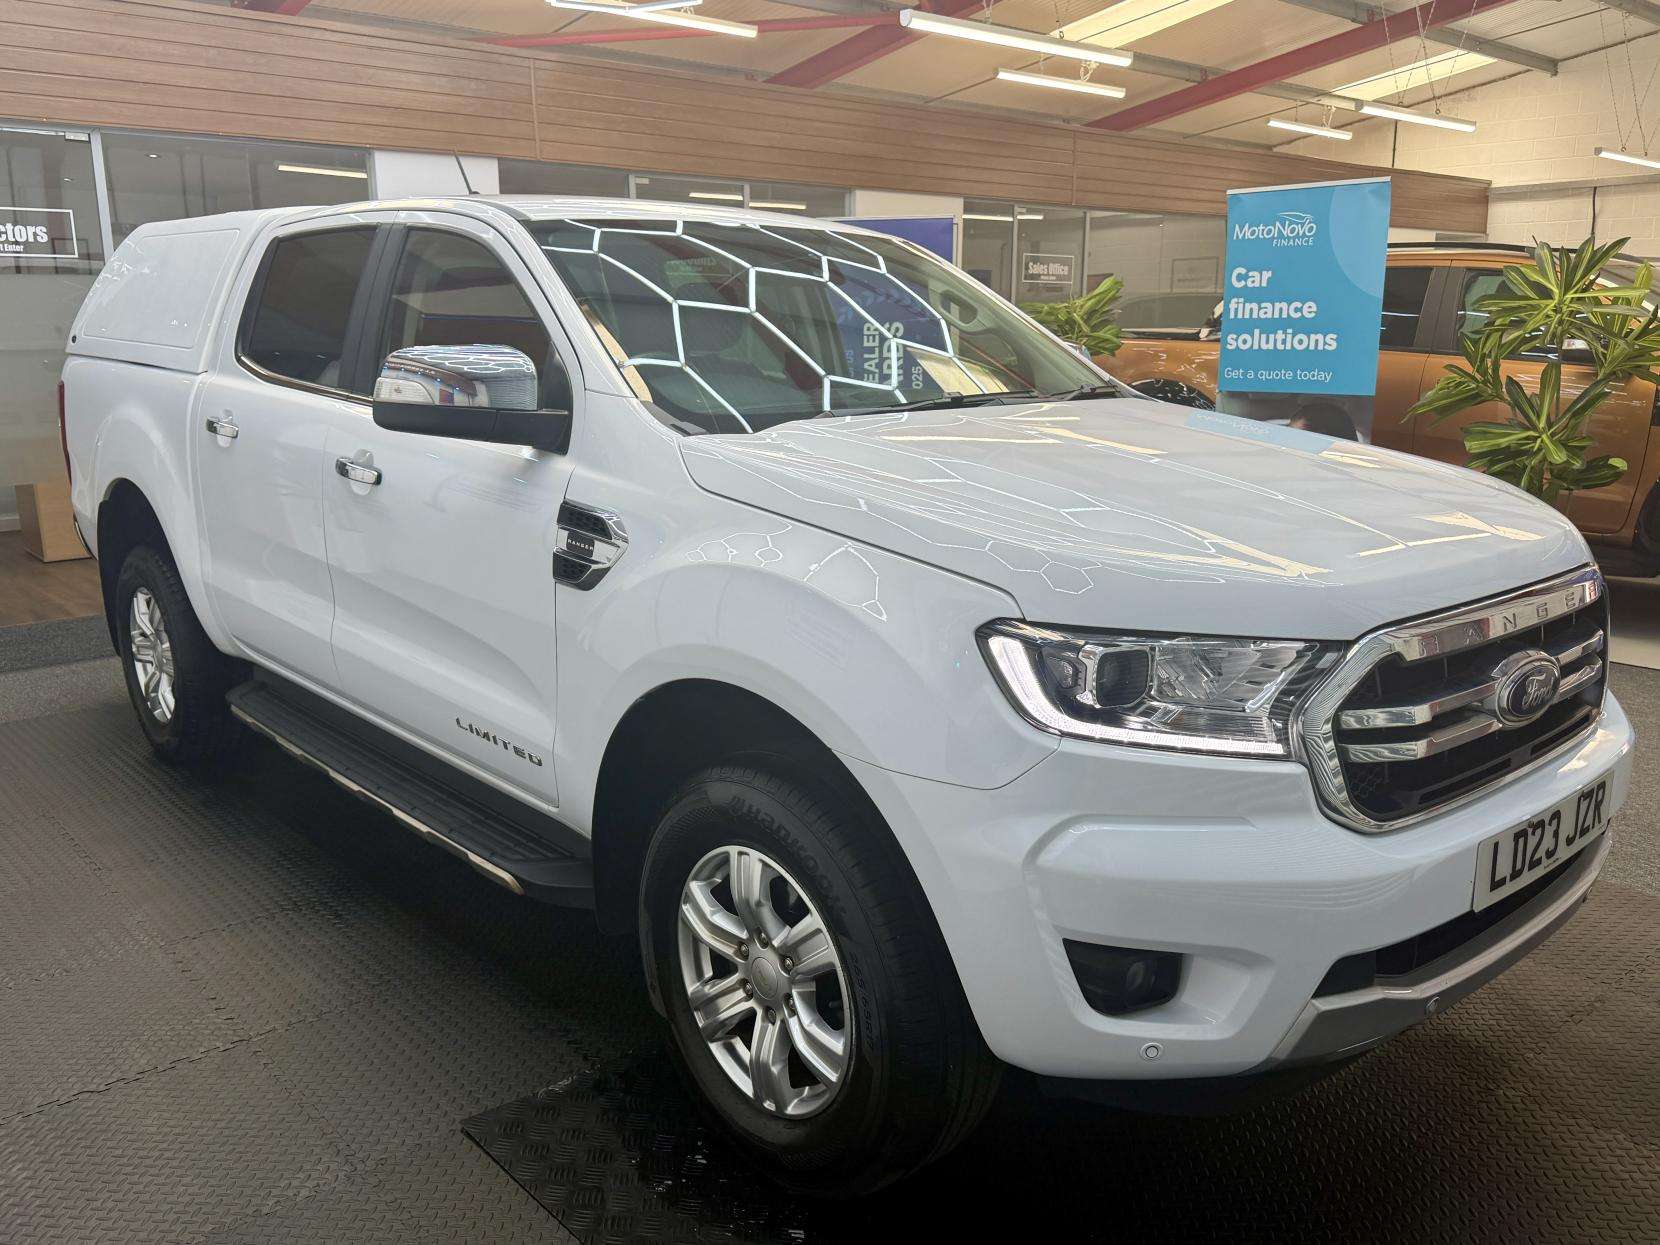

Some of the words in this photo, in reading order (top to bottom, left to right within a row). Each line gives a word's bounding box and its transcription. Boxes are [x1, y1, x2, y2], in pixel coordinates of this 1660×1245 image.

[1233, 220, 1317, 240] MotoNovo
[4, 243, 24, 252] Enter
[1272, 237, 1314, 247] FINANCE
[1028, 262, 1048, 274] Sales
[1048, 263, 1068, 275] Office
[1231, 267, 1272, 288] Car
[1229, 298, 1317, 319] finance
[1226, 328, 1338, 351] solutions
[1224, 367, 1243, 379] Get
[1246, 370, 1254, 379] a
[1257, 368, 1293, 381] quote
[1297, 368, 1333, 382] today
[568, 539, 594, 551] RANGER
[456, 717, 543, 767] LIMITED
[1489, 809, 1562, 893] LD23
[1566, 780, 1607, 847] JZR
